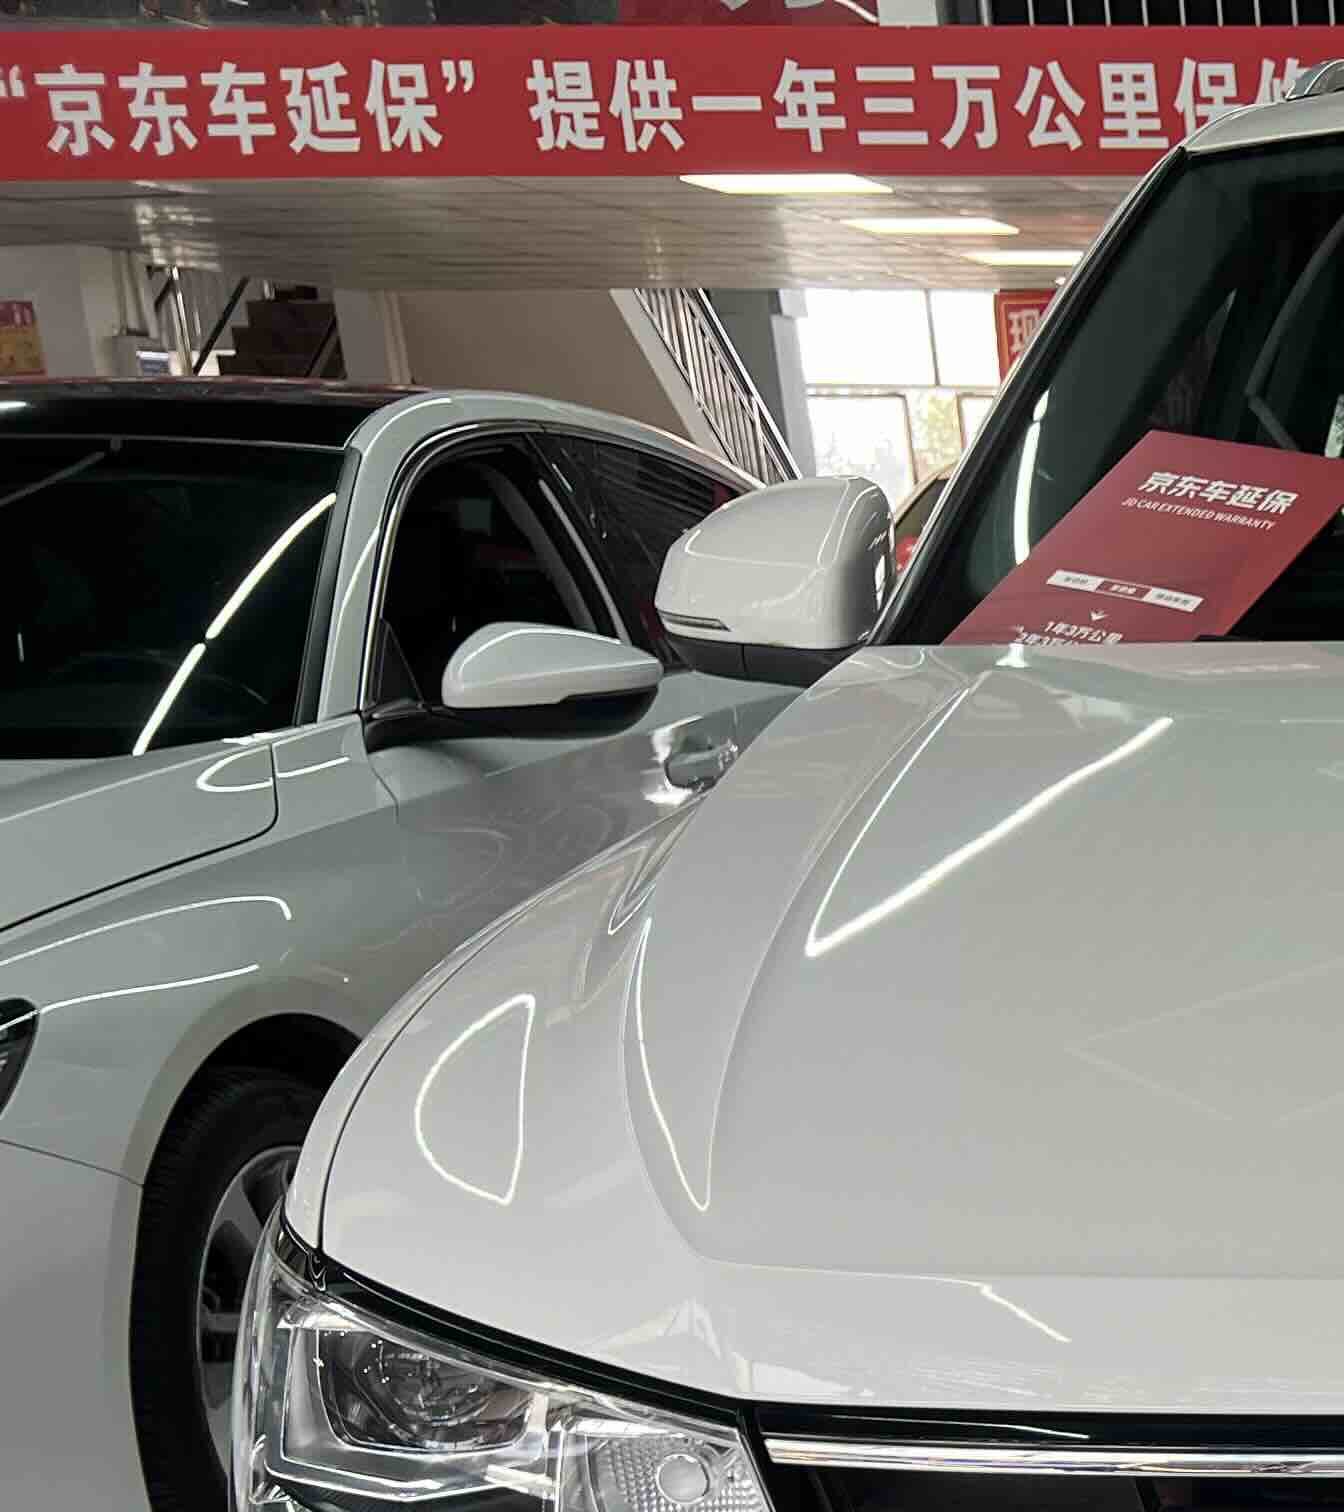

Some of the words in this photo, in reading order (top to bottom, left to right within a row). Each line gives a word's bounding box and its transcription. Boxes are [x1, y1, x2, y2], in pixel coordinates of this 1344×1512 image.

[1137, 471, 1299, 515] 京东车延保
[1137, 499, 1158, 512] CAR
[1157, 503, 1215, 521] EXTENDED
[1215, 511, 1277, 531] WARRANTY
